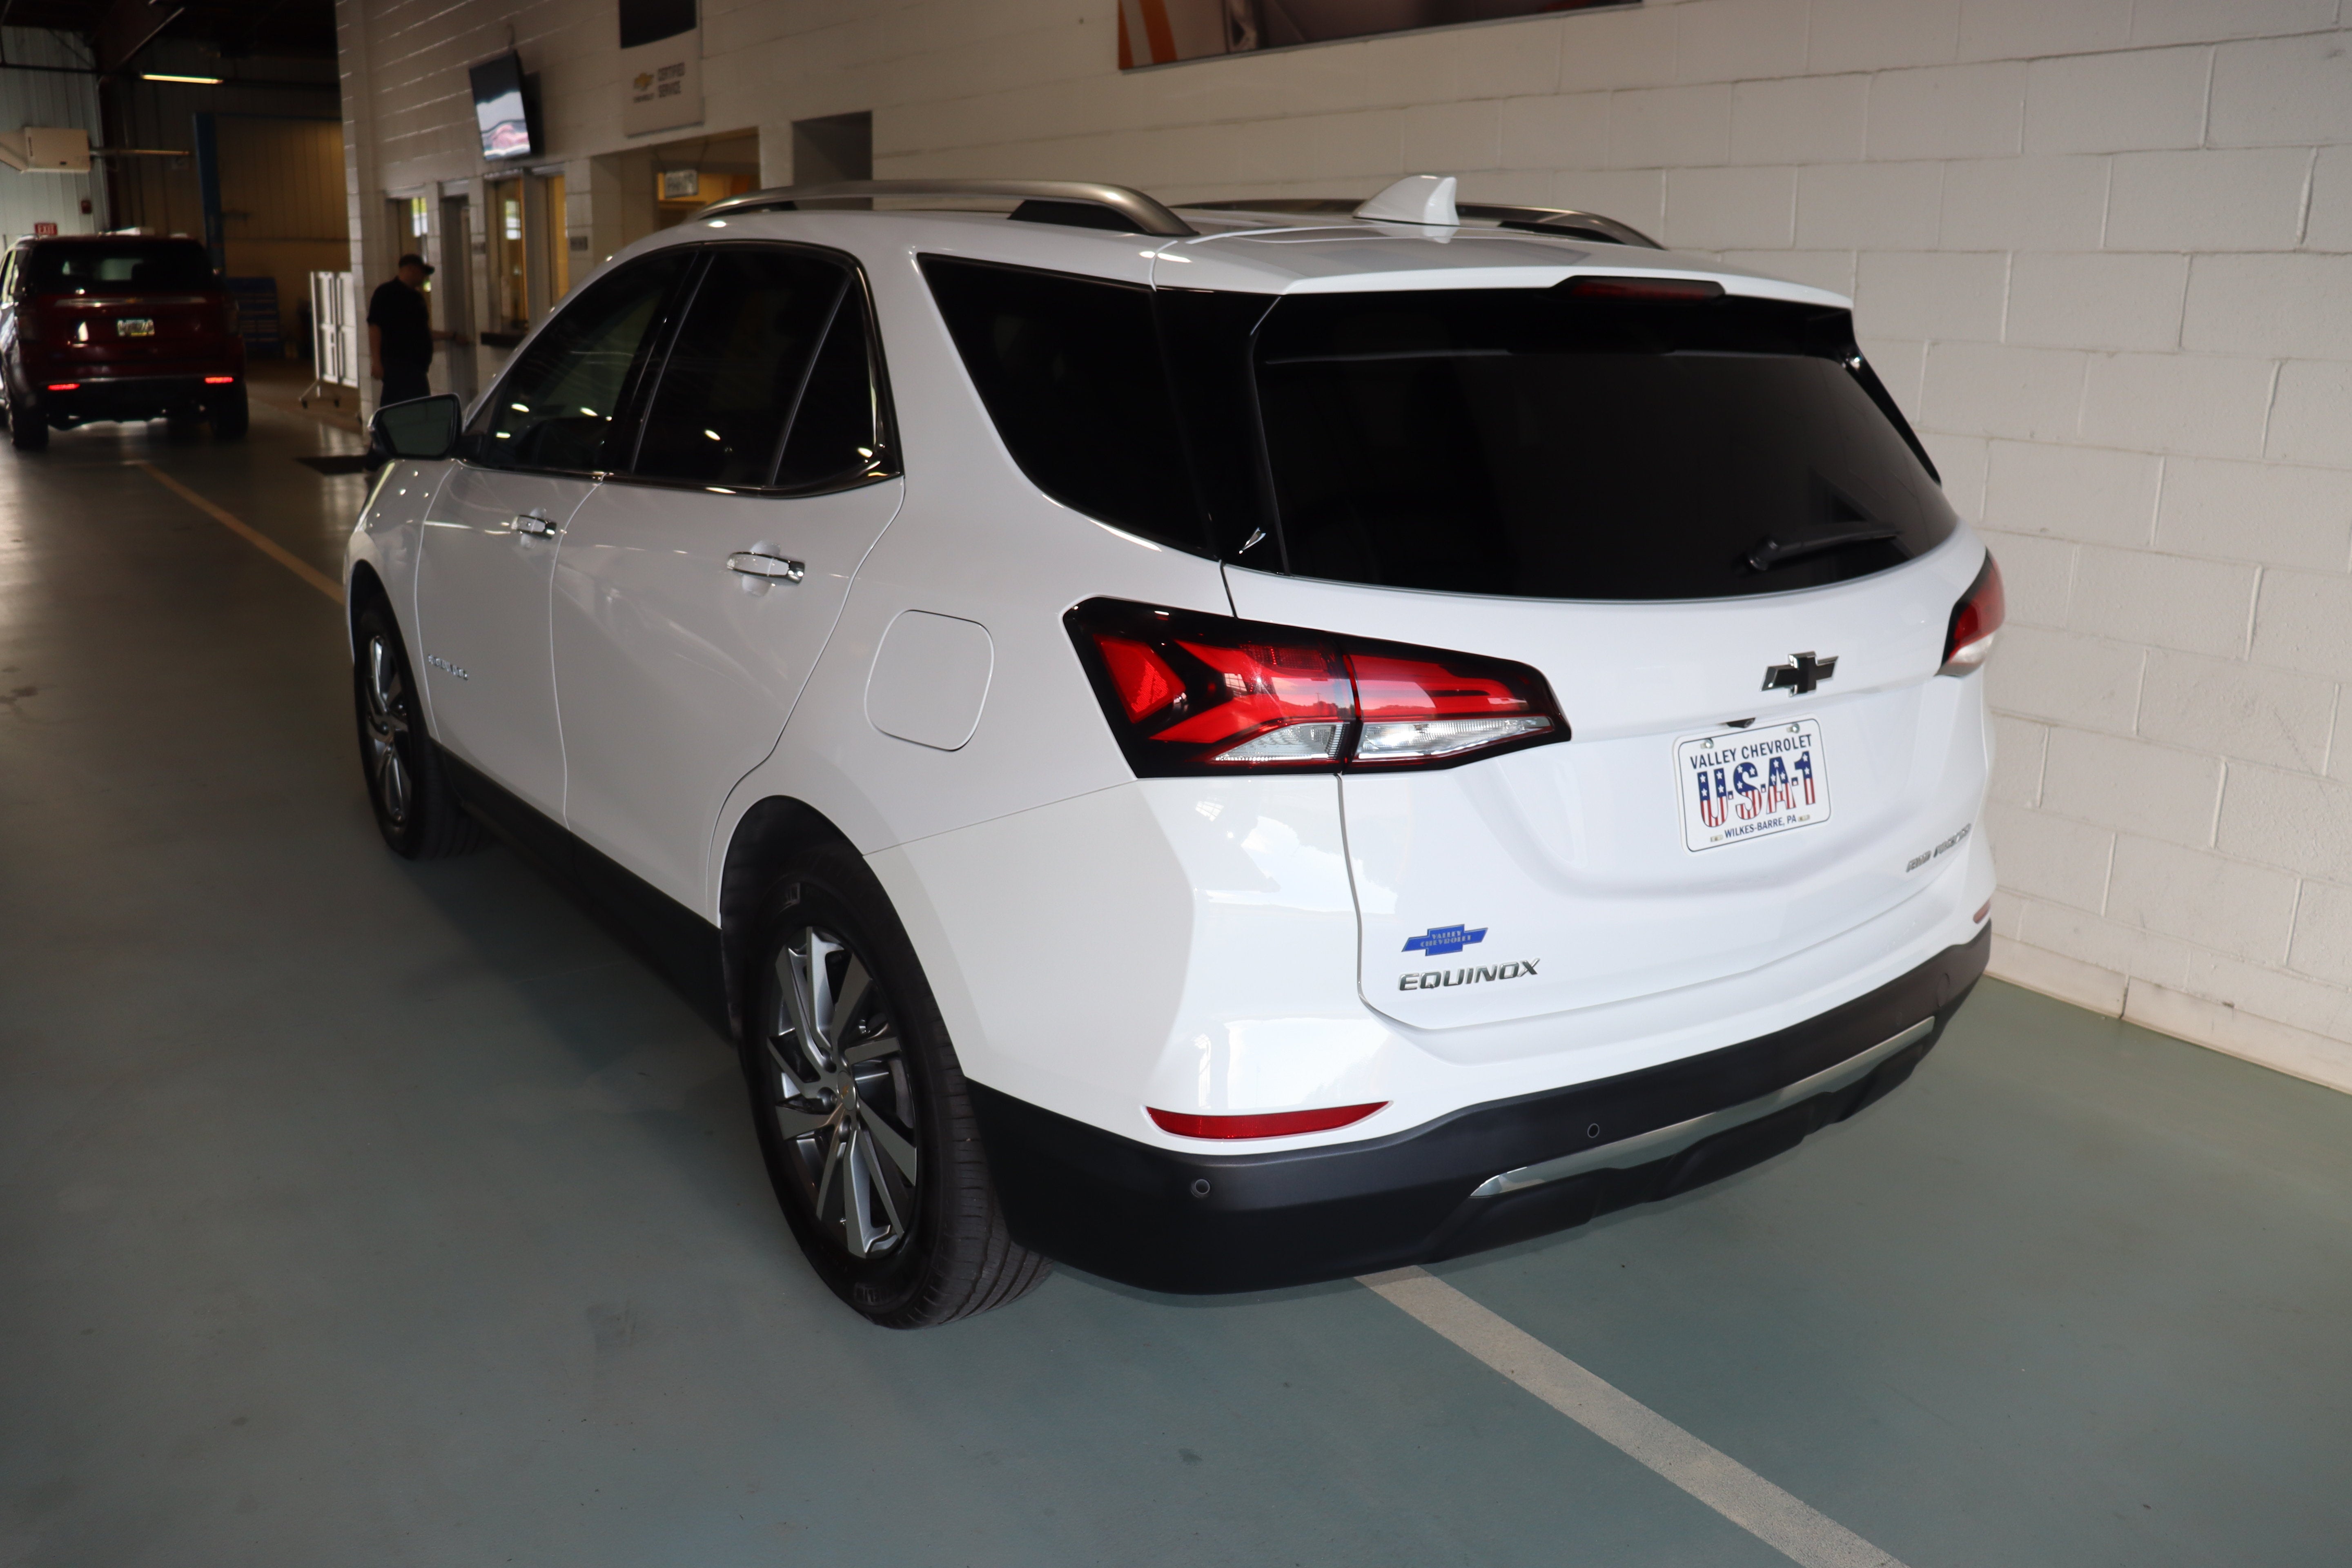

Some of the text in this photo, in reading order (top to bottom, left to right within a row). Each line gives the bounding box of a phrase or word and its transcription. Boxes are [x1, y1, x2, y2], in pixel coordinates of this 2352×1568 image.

[38, 224, 54, 234] EXIT
[1690, 734, 1812, 769] VALLEY CHEVROLET
[1724, 815, 1797, 838] WILKES-BARRE, PA
[1420, 935, 1472, 947] CHEVROLET
[1432, 931, 1461, 940] VALLEY
[1398, 957, 1540, 991] EQUINOX
